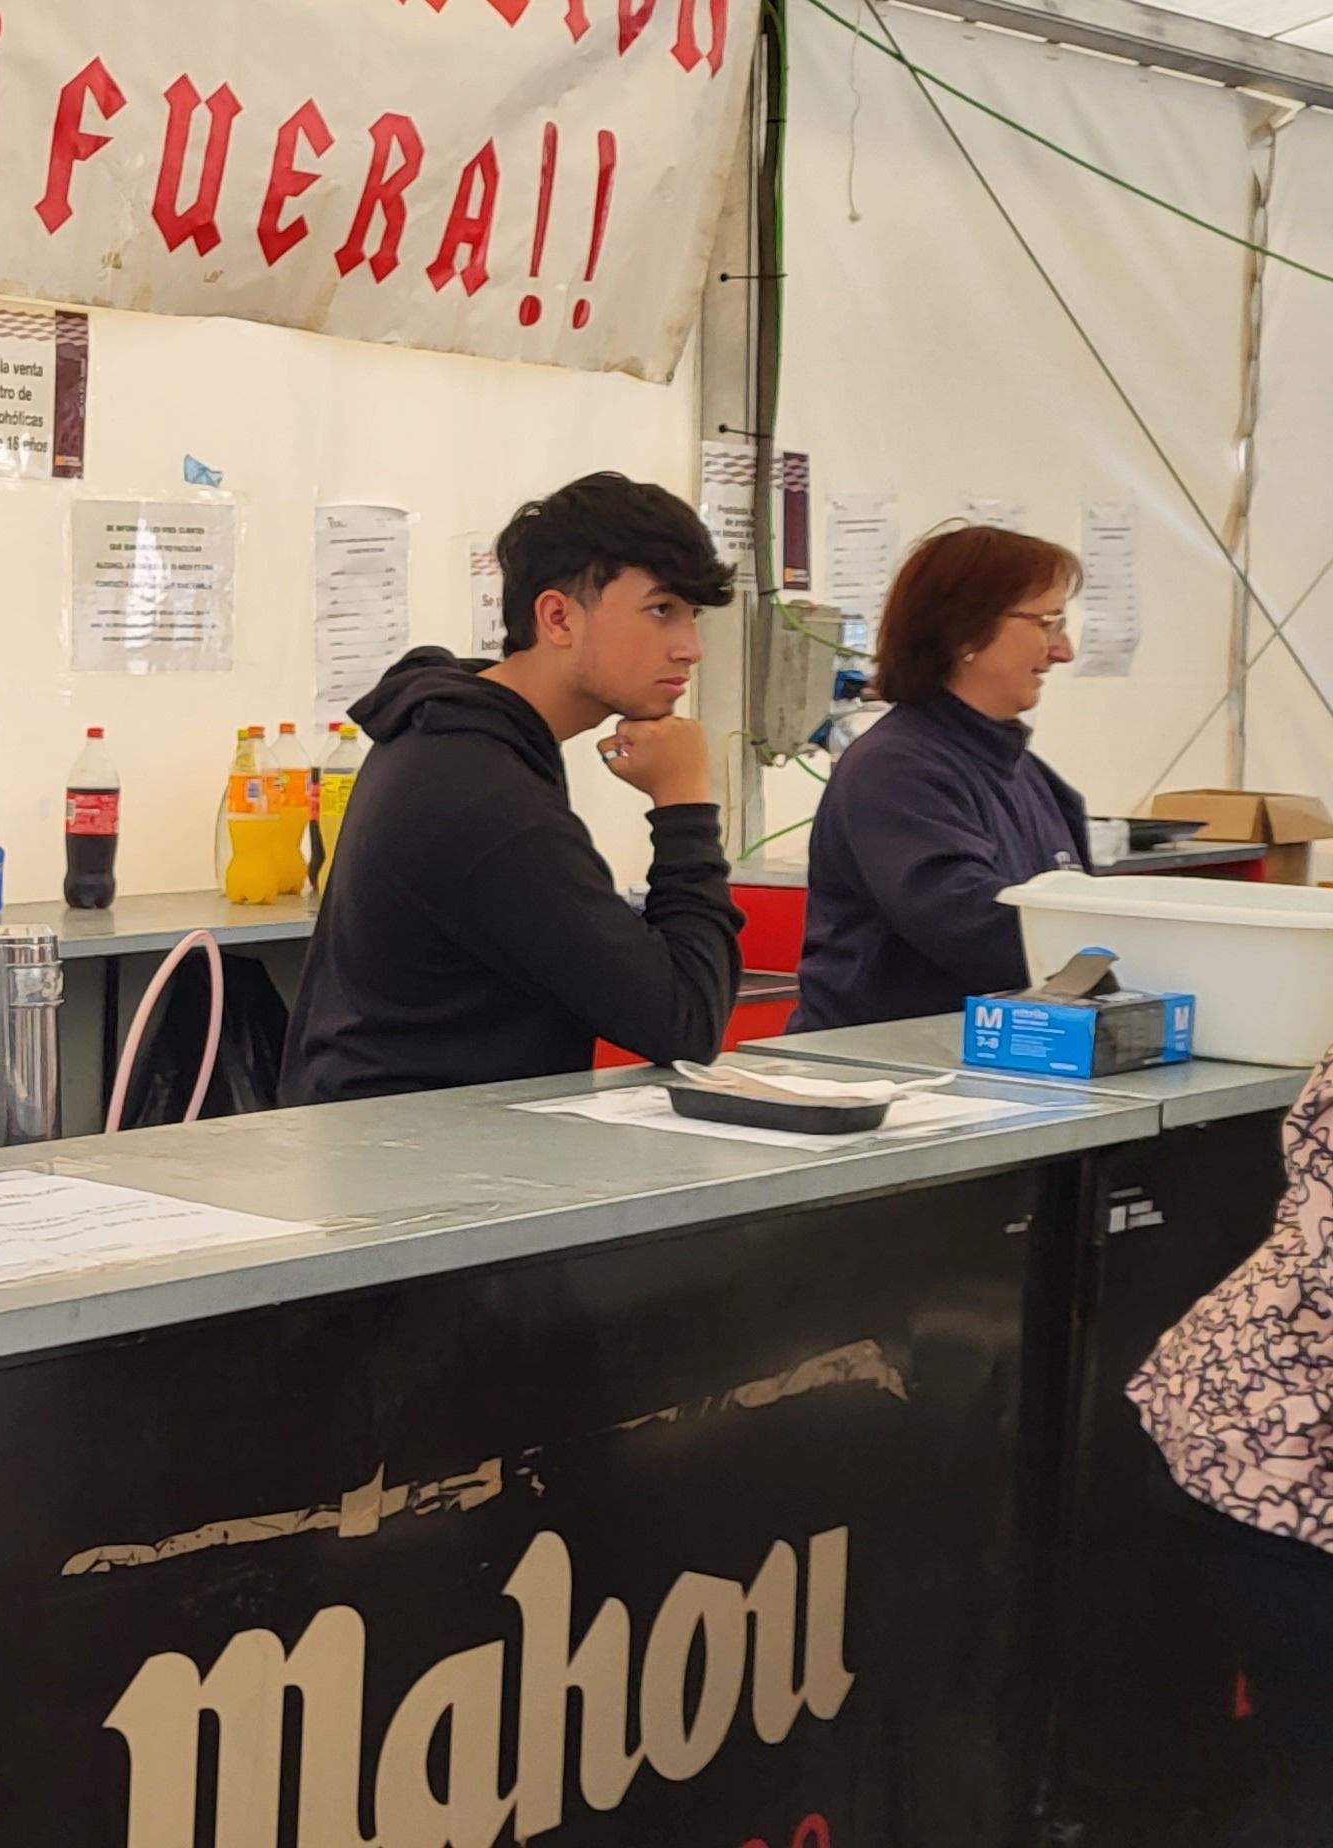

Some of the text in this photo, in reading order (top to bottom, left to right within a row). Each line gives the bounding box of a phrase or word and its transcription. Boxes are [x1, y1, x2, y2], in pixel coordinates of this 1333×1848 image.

[0, 358, 10, 374] la
[13, 361, 44, 377] venta
[18, 386, 33, 401] de
[975, 1005, 1003, 1029] M
